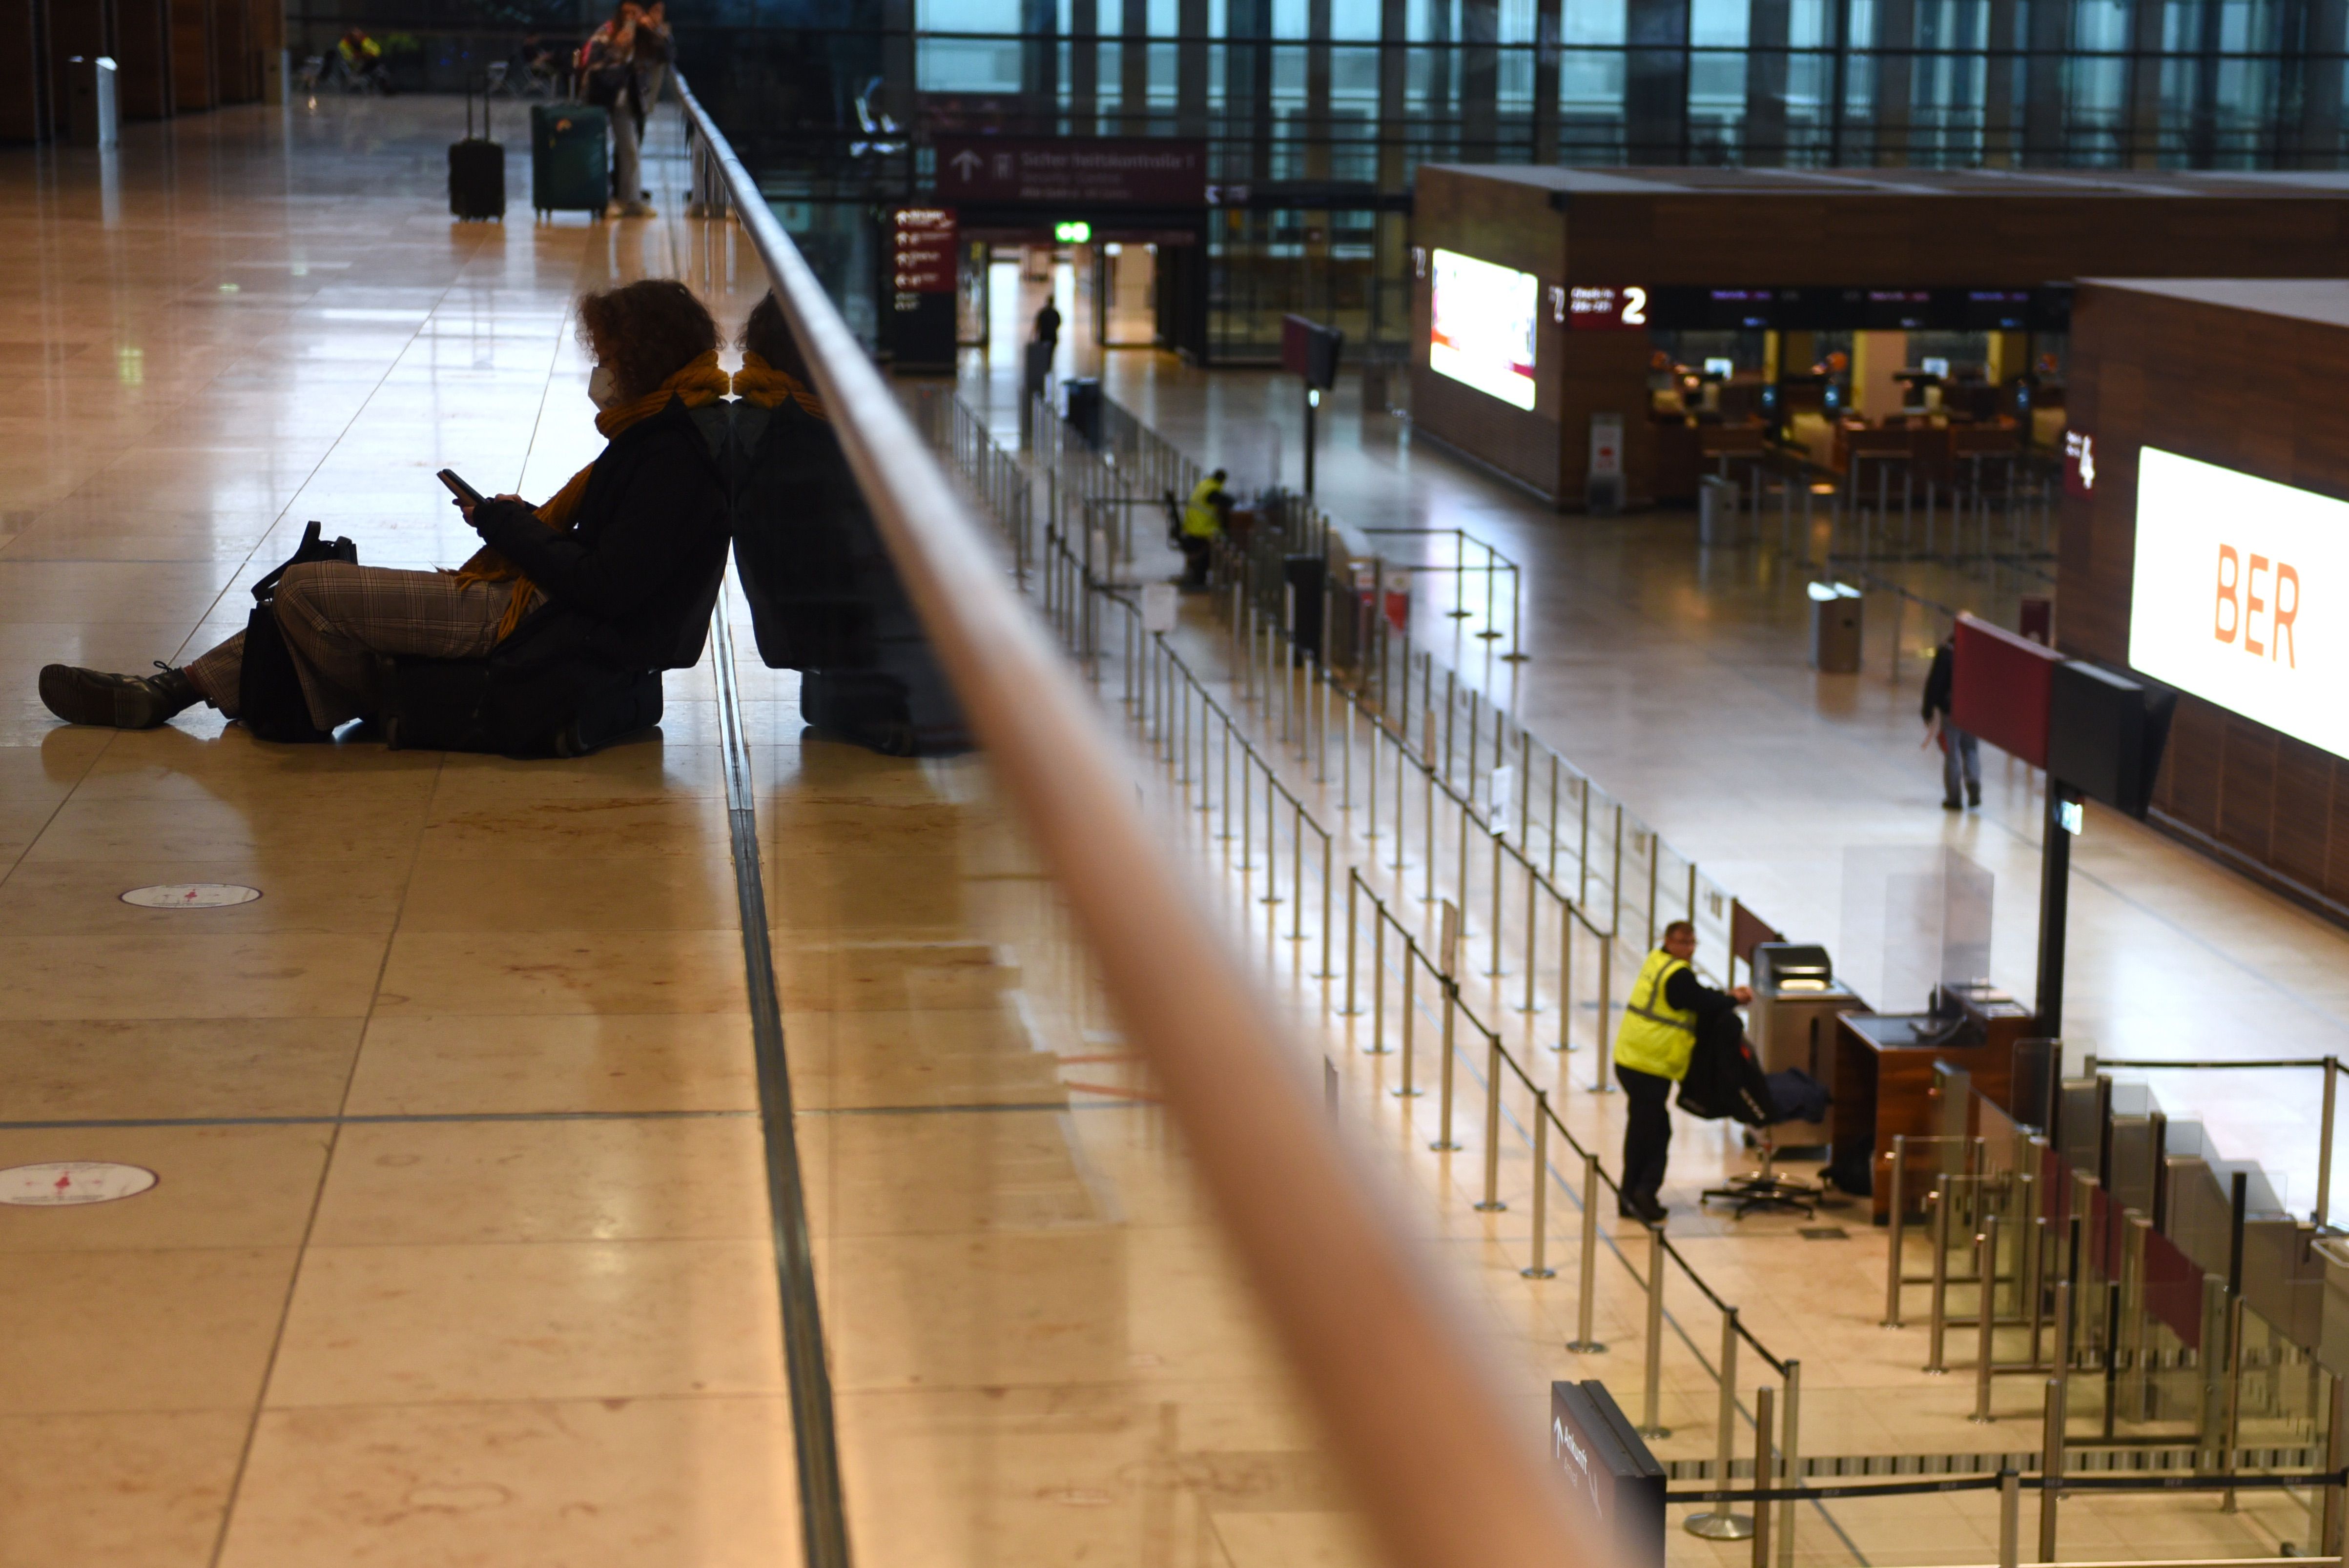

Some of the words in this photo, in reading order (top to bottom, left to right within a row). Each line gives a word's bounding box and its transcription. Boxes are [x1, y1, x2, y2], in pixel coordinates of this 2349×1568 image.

[1621, 286, 1647, 325] 2
[2214, 543, 2301, 669] BER
[1564, 1426, 1587, 1475] Ankunft
